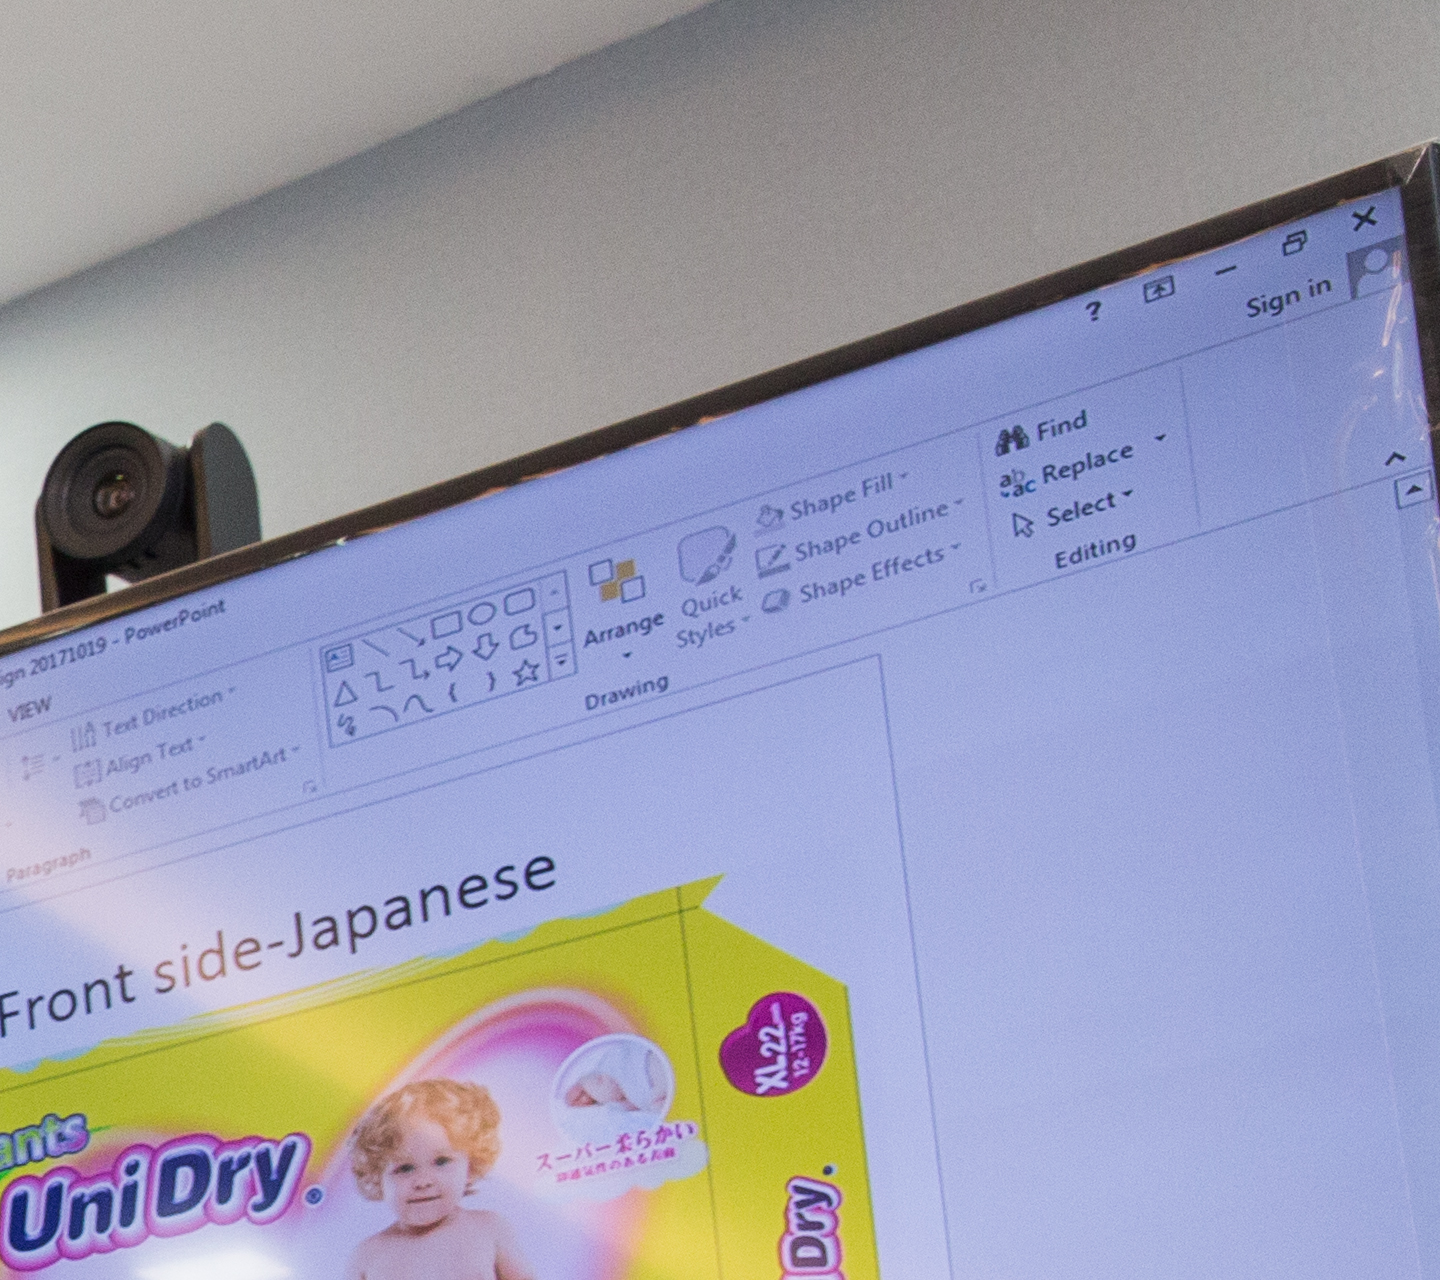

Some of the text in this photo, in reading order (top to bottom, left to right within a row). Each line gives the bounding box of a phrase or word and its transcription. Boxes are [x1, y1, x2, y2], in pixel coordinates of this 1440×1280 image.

[1246, 276, 1333, 320] Sign in
[1036, 409, 1088, 443] Find
[1041, 441, 1135, 485] Replace
[790, 471, 894, 523] Shape Fill
[1046, 490, 1117, 529] Select
[795, 499, 950, 563] Shape Outline
[1054, 532, 1138, 571] Editing
[799, 544, 946, 605] Shape Effects
[123, 599, 227, 646] PowerPoint
[680, 583, 744, 619] Quick
[583, 609, 666, 650] Arrange
[676, 615, 737, 649] Styles
[7, 694, 53, 724] VIEW
[102, 688, 225, 738] Text Direction
[584, 672, 671, 713] Drawing
[105, 735, 195, 780] Align Text
[108, 746, 288, 815] Convert to SmartArt
[5, 846, 92, 884] Paragraph
[152, 854, 559, 996] side-Japanese
[791, 1011, 810, 1078] 12-17kg
